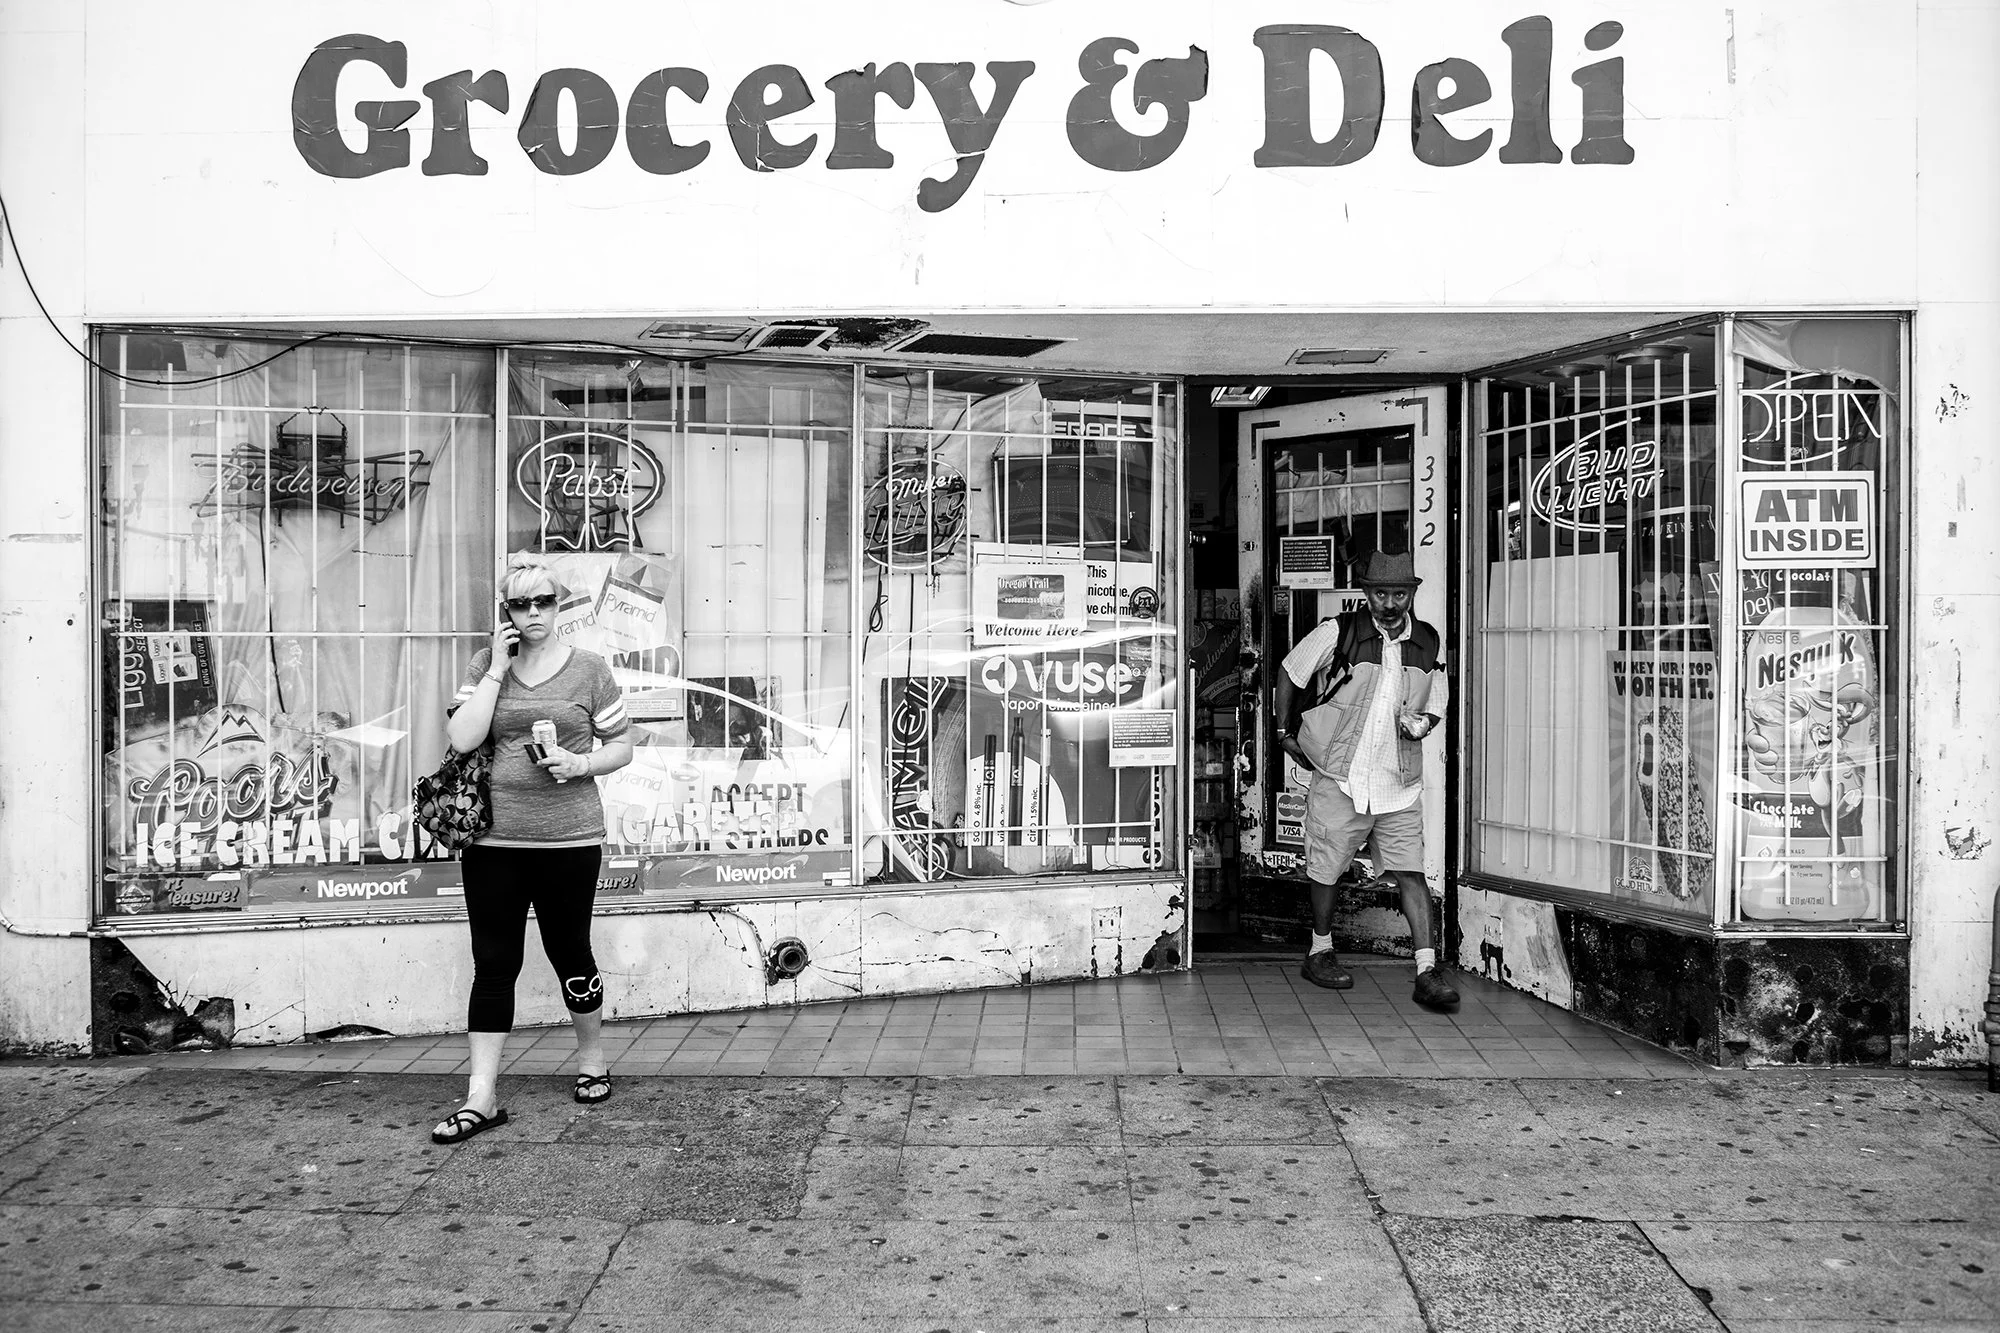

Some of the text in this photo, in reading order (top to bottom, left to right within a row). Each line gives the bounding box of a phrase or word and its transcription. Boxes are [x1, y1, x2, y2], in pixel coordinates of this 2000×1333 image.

[292, 16, 1635, 212] Grocery & Deli
[1742, 392, 1882, 442] OPEN
[1567, 441, 1656, 482] BUD
[195, 460, 406, 497] Budweiser
[543, 452, 642, 498] Pabst
[886, 474, 957, 500] Miler
[1546, 469, 1665, 515] LIGHT
[1754, 488, 1859, 522] ATM
[1750, 528, 1865, 551] INSIDE
[1030, 577, 1049, 589] Trail
[1776, 569, 1833, 581] Cocolat
[1087, 583, 1130, 598] nicotie.
[604, 592, 657, 623] Pyramid
[985, 624, 1079, 637] Welcome Here
[110, 618, 147, 709] Ligge
[194, 622, 210, 685] KING OF LOW PCE
[1647, 661, 1679, 675] YUR
[1682, 662, 1713, 676] TOP
[1614, 675, 1714, 700] WORTH IT.
[611, 769, 664, 792] yramid
[128, 745, 339, 851] Coors
[1030, 800, 1038, 819] 1.5%
[1278, 802, 1306, 811] MasterCard
[973, 782, 982, 842] soo 4.8% nic.
[1774, 816, 1802, 829] Mlk
[136, 821, 202, 867] ICE
[216, 818, 360, 866] CREAM
[1282, 826, 1301, 836] VISA
[595, 873, 638, 890] sure!
[716, 863, 797, 884] Newport
[317, 878, 408, 900] Newport
[1636, 881, 1666, 897] HUMR
